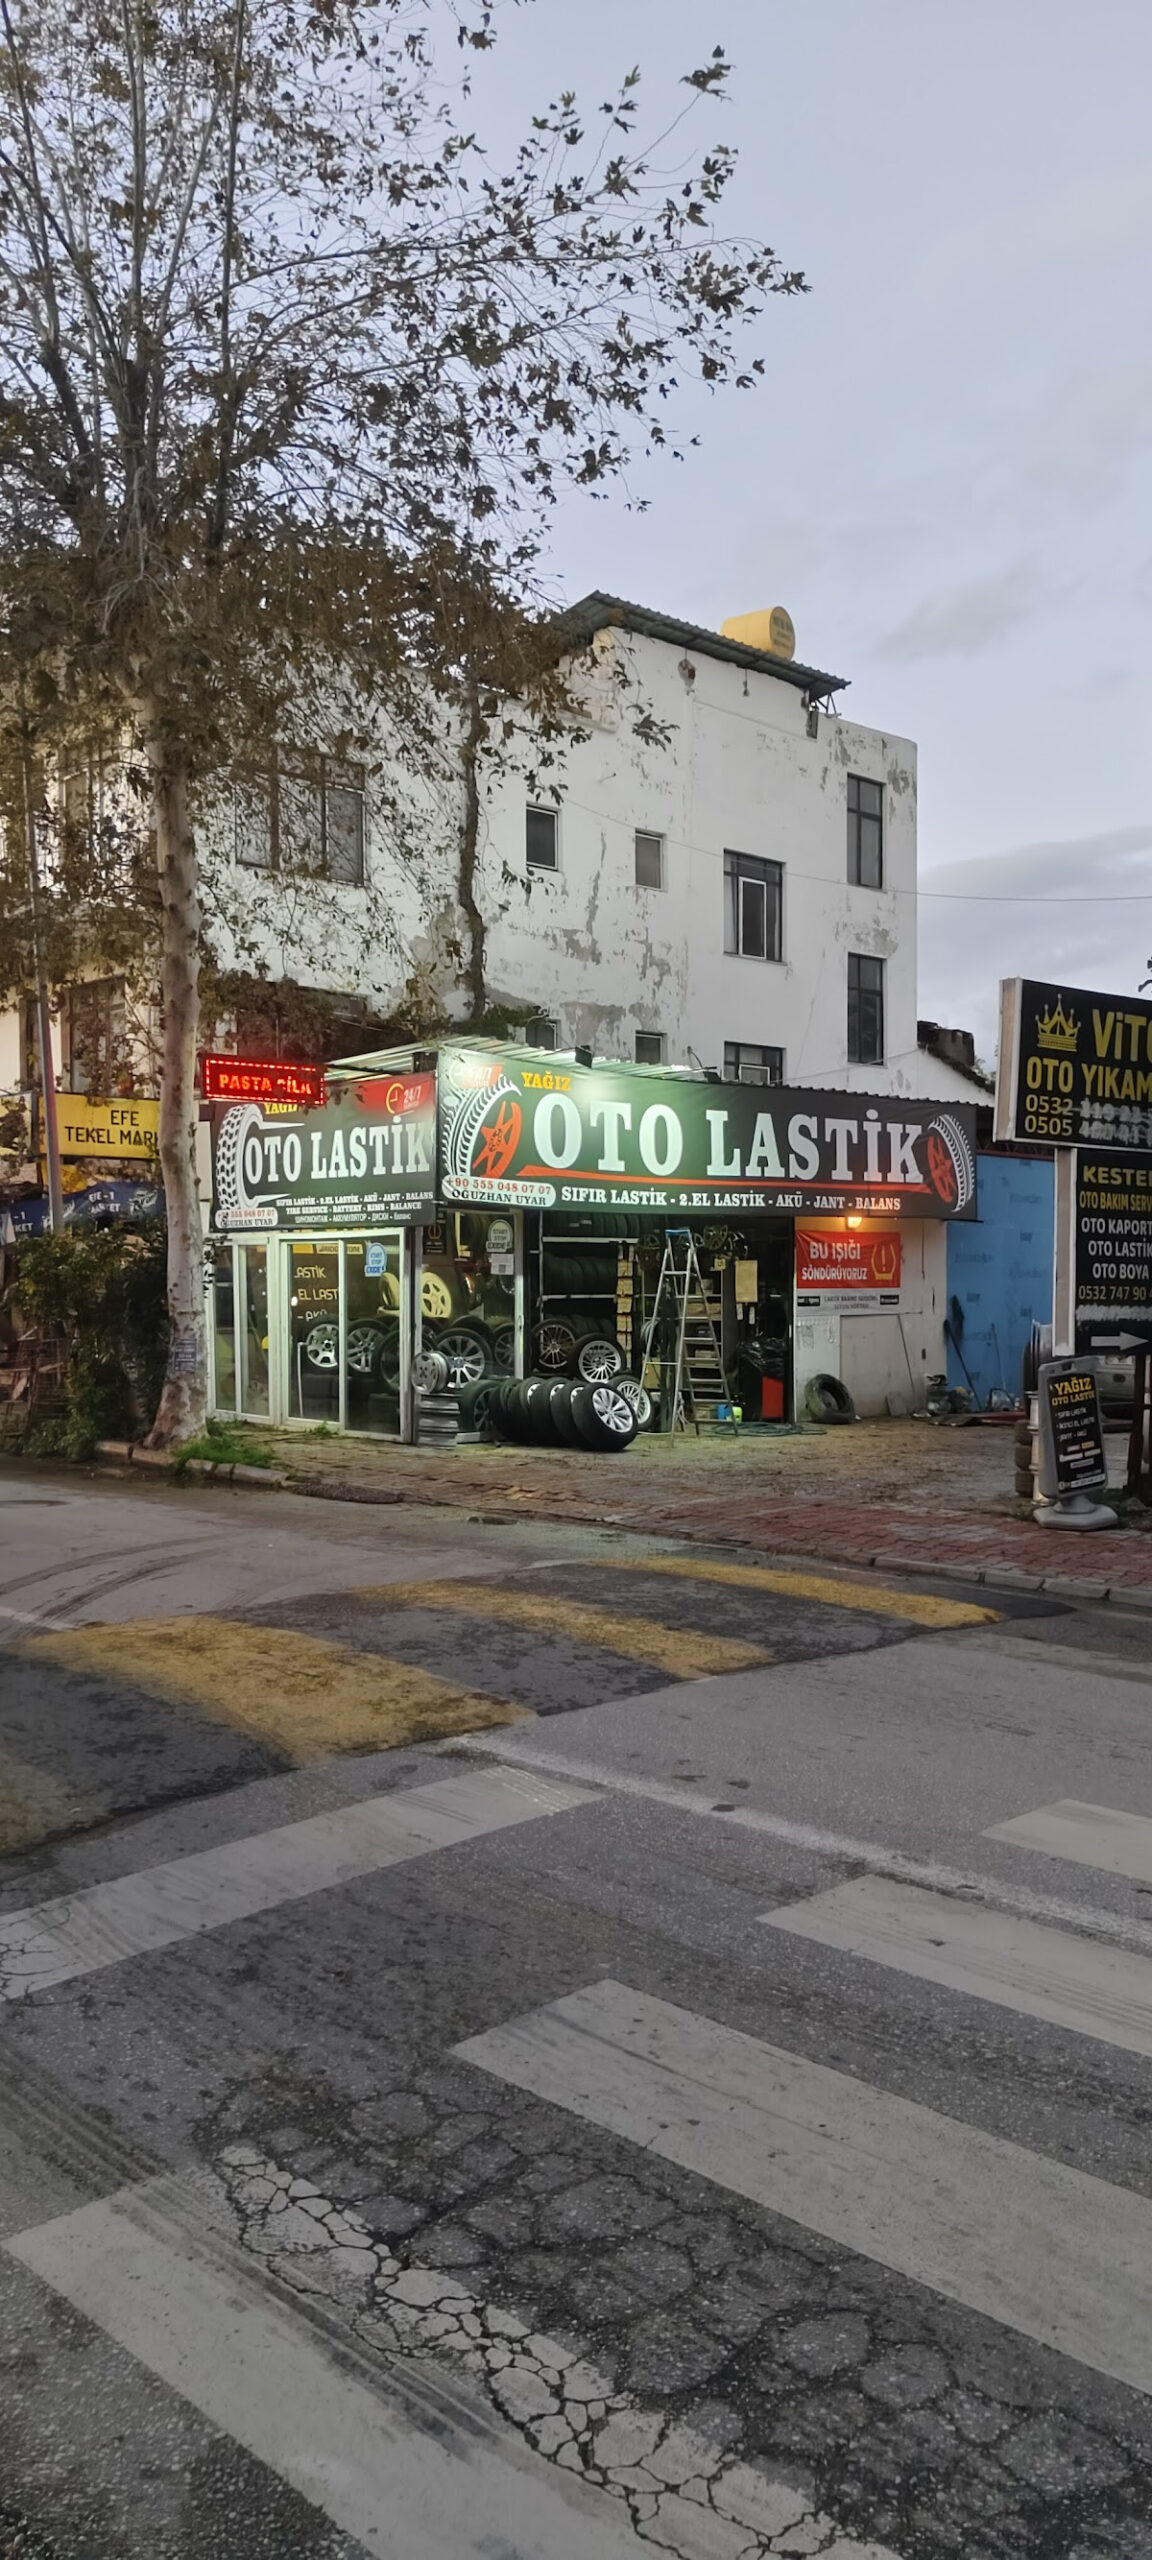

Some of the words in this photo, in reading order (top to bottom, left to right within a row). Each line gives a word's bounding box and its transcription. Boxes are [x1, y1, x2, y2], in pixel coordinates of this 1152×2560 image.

[1092, 1009, 1152, 1062] ViT
[219, 1074, 272, 1092] PASTA
[521, 1070, 571, 1091] YAĞIZ
[1026, 1056, 1073, 1093] OTO
[1025, 1094, 1073, 1116] 0532
[110, 1110, 139, 1126] EFE
[1024, 1115, 1072, 1137] 0505
[64, 1126, 115, 1144] TEKEL
[533, 1093, 683, 1177] OTO
[706, 1109, 924, 1185] LASTİK
[245, 1133, 302, 1184] OTO
[311, 1115, 430, 1179] LASTİK
[1083, 1165, 1152, 1188] KESTE
[473, 1180, 494, 1190] 555
[498, 1182, 518, 1192] 048
[522, 1184, 535, 1194] 07
[538, 1186, 552, 1195] 07
[293, 1196, 315, 1206] LASTİK
[335, 1194, 359, 1204] LASTİK
[405, 1192, 433, 1200] BALANS
[390, 1202, 422, 1210] BALANCE
[516, 1195, 546, 1206] UYAR
[562, 1186, 606, 1203] SIFIR
[610, 1187, 667, 1206] LASTİK
[679, 1193, 711, 1207] 2.EL
[713, 1190, 765, 1207] LASTİK
[776, 1191, 803, 1208] AKÜ
[813, 1196, 845, 1209] JANT
[855, 1197, 900, 1210] BALANS
[1079, 1191, 1098, 1208] OTO
[1100, 1192, 1129, 1210] BAKIM
[1081, 1217, 1105, 1234] OTO
[810, 1241, 828, 1260] BU
[832, 1239, 860, 1262] IŞIĞI
[1088, 1240, 1112, 1256] OTO
[801, 1264, 867, 1281] SÖNDÜRÜYORUZ
[1092, 1263, 1117, 1279] OTO
[1119, 1263, 1149, 1280] BOYA
[298, 1288, 311, 1300] EL
[1079, 1285, 1106, 1300] 0532
[1110, 1286, 1130, 1300] 747
[1133, 1286, 1147, 1301] 90
[1055, 1376, 1092, 1397] YAĞIZ
[1051, 1396, 1069, 1406] OTO
